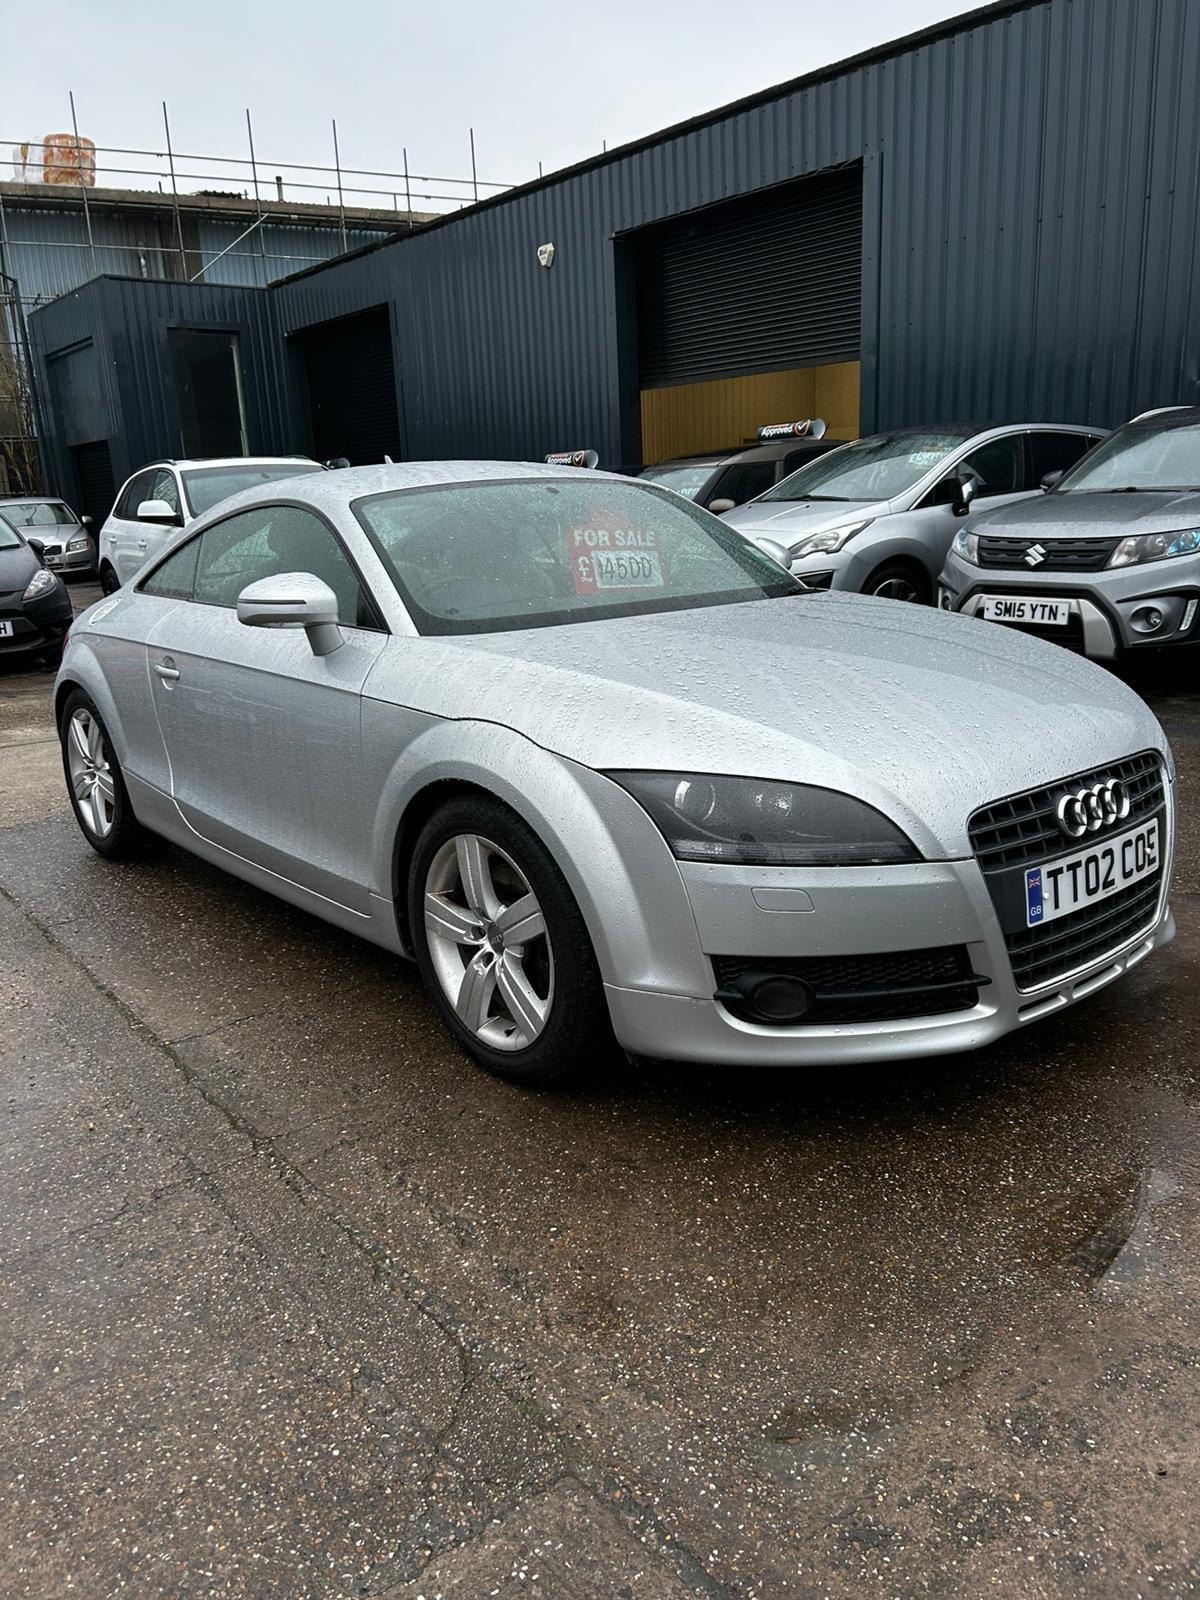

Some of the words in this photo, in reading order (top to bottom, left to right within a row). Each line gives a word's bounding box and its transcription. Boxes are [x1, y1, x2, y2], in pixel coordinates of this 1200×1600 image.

[761, 423, 794, 437] Approved
[547, 455, 572, 465] Approved
[574, 530, 610, 547] FOR
[614, 529, 656, 547] SALE
[994, 601, 1026, 618] SM15
[1030, 603, 1059, 621] YTN
[1047, 848, 1116, 910] TT02
[1121, 825, 1157, 880] COE
[1030, 904, 1042, 917] GB
